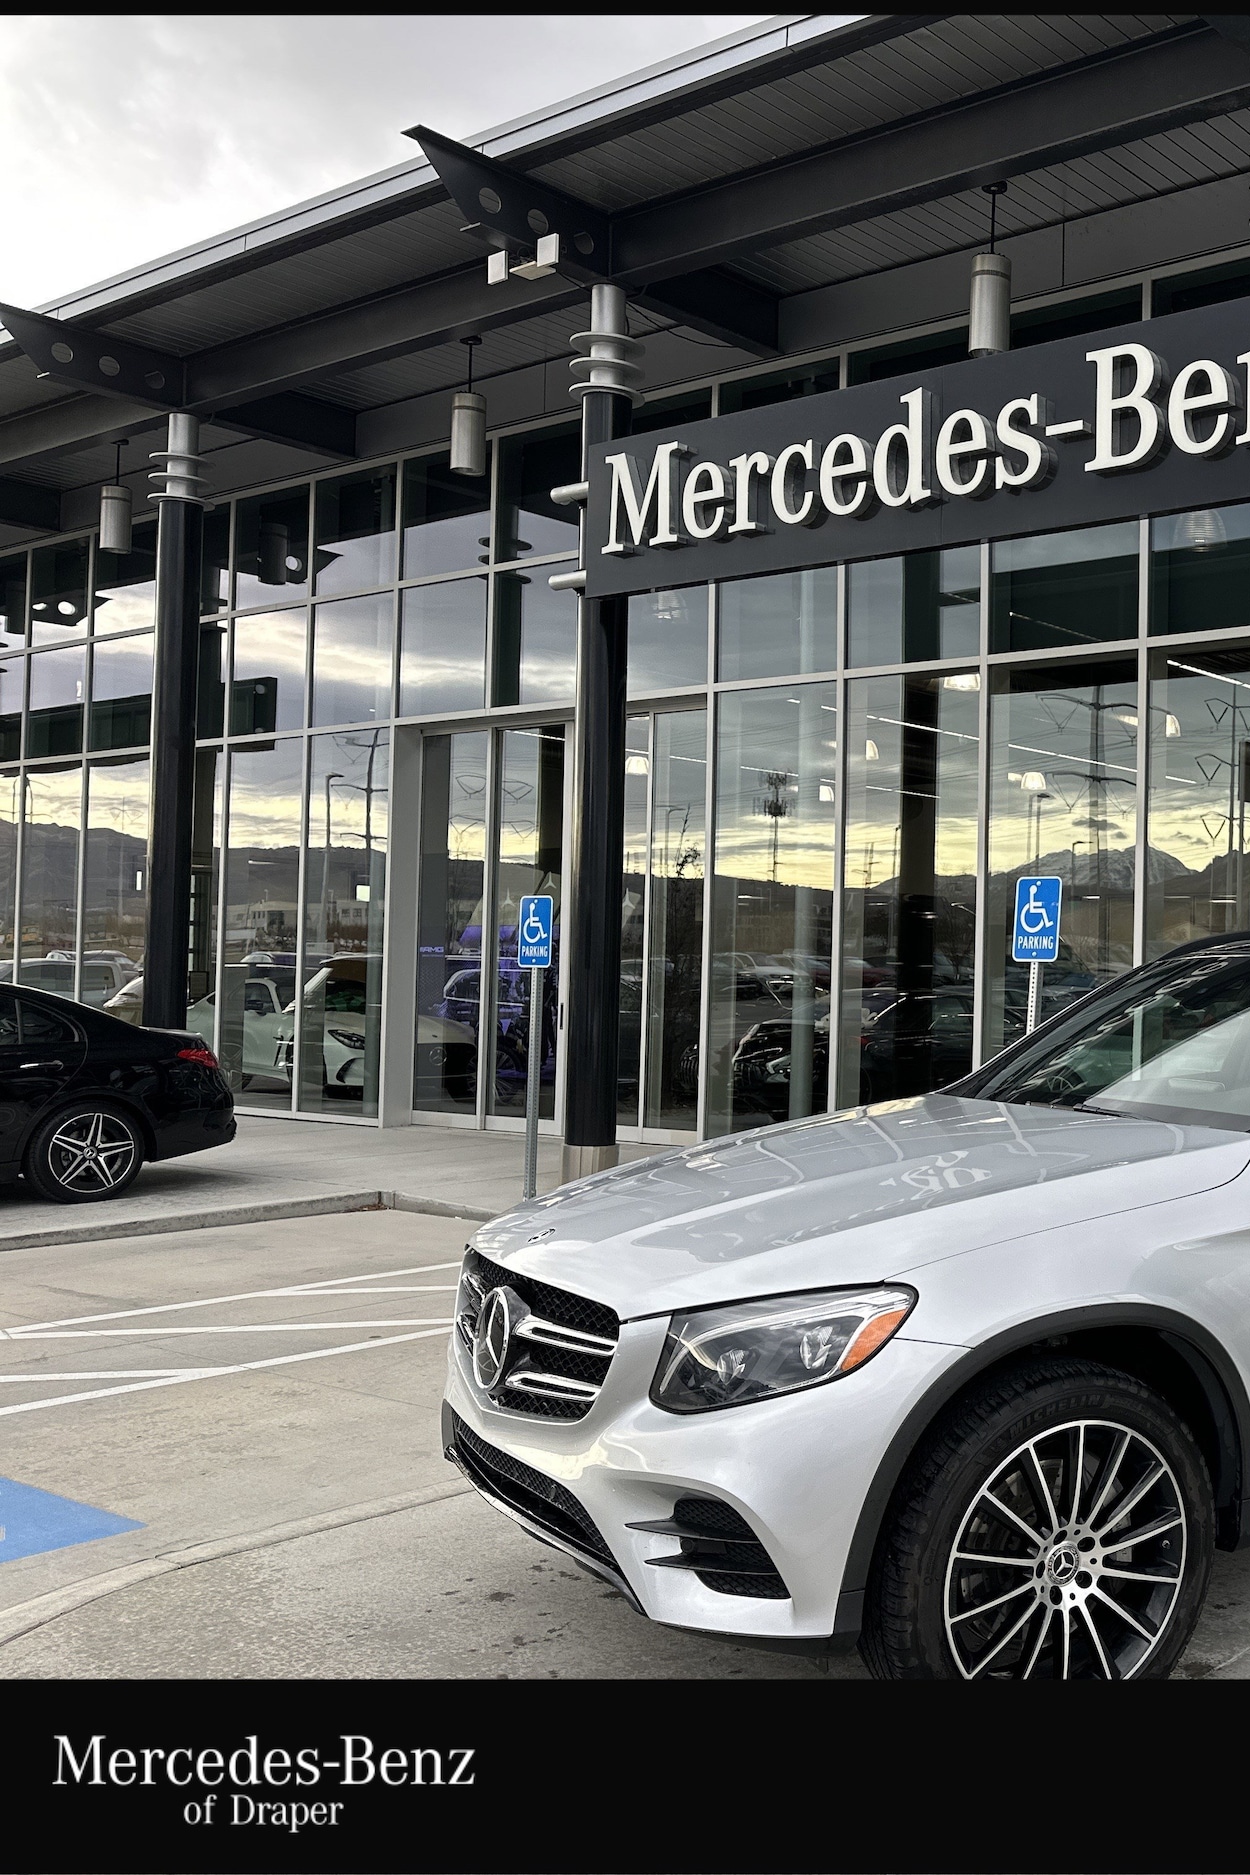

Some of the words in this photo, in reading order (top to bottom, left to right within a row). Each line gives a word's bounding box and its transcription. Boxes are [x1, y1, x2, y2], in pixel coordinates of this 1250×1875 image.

[1017, 935, 1054, 950] PARKING
[521, 945, 549, 958] PARKING
[1008, 1393, 1102, 1440] MICHELIN
